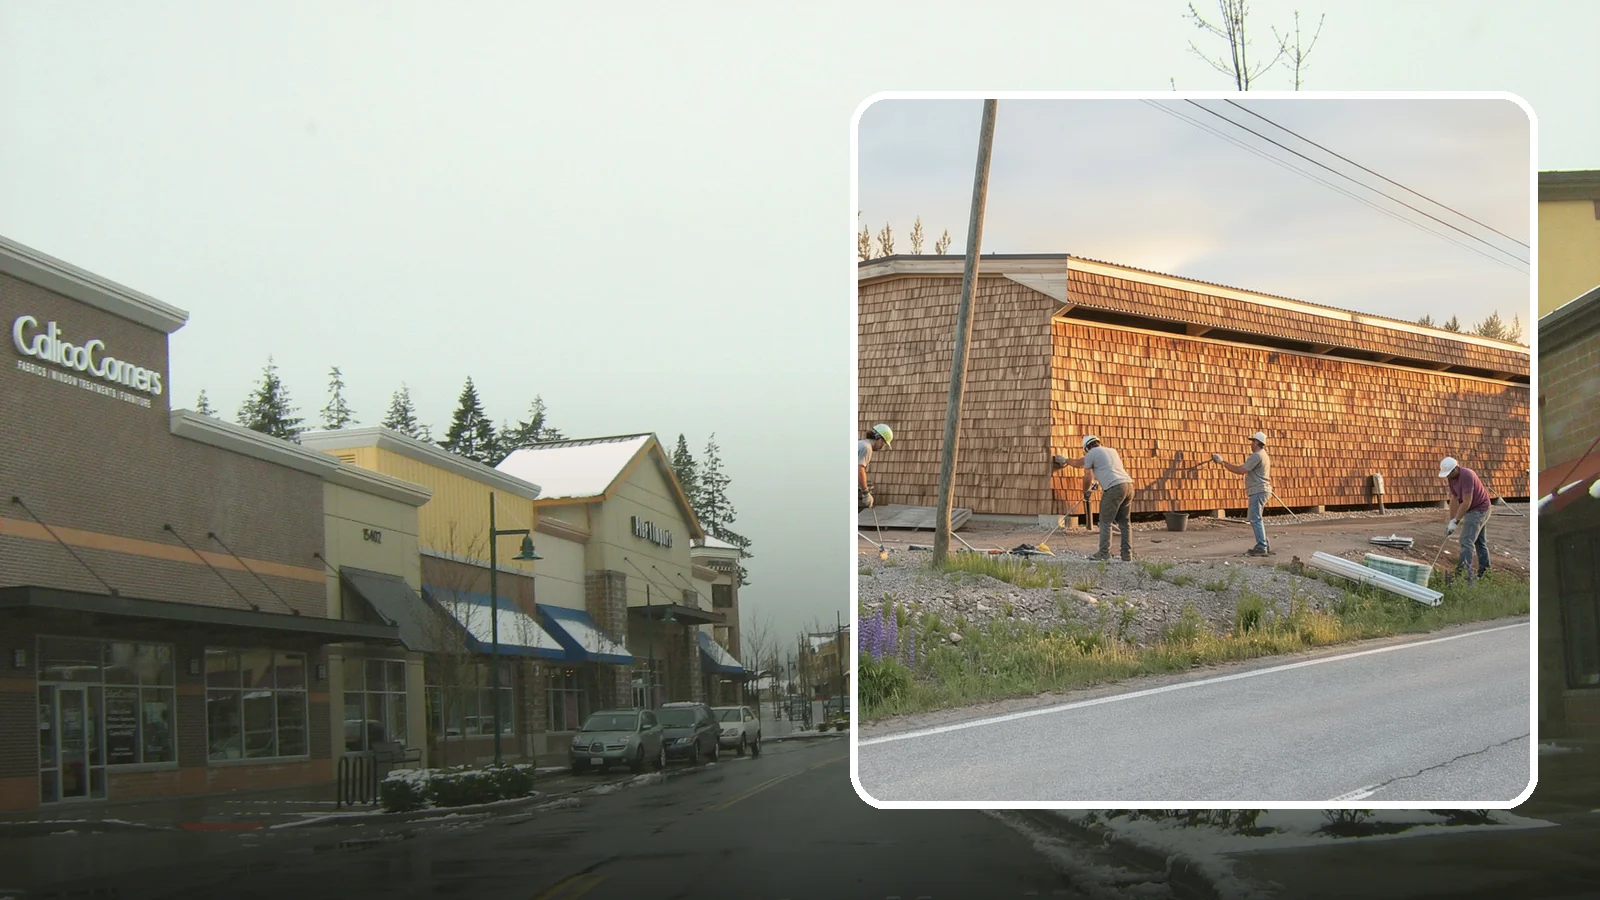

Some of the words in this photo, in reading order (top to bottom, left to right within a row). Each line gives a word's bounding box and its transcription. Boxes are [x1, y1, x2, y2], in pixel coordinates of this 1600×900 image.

[12, 315, 162, 395] CalicoCorners
[17, 360, 47, 377] FABRICS
[50, 370, 78, 387] WINDOW
[78, 378, 116, 398] TREATMENTS
[119, 391, 152, 409] FURNITURE
